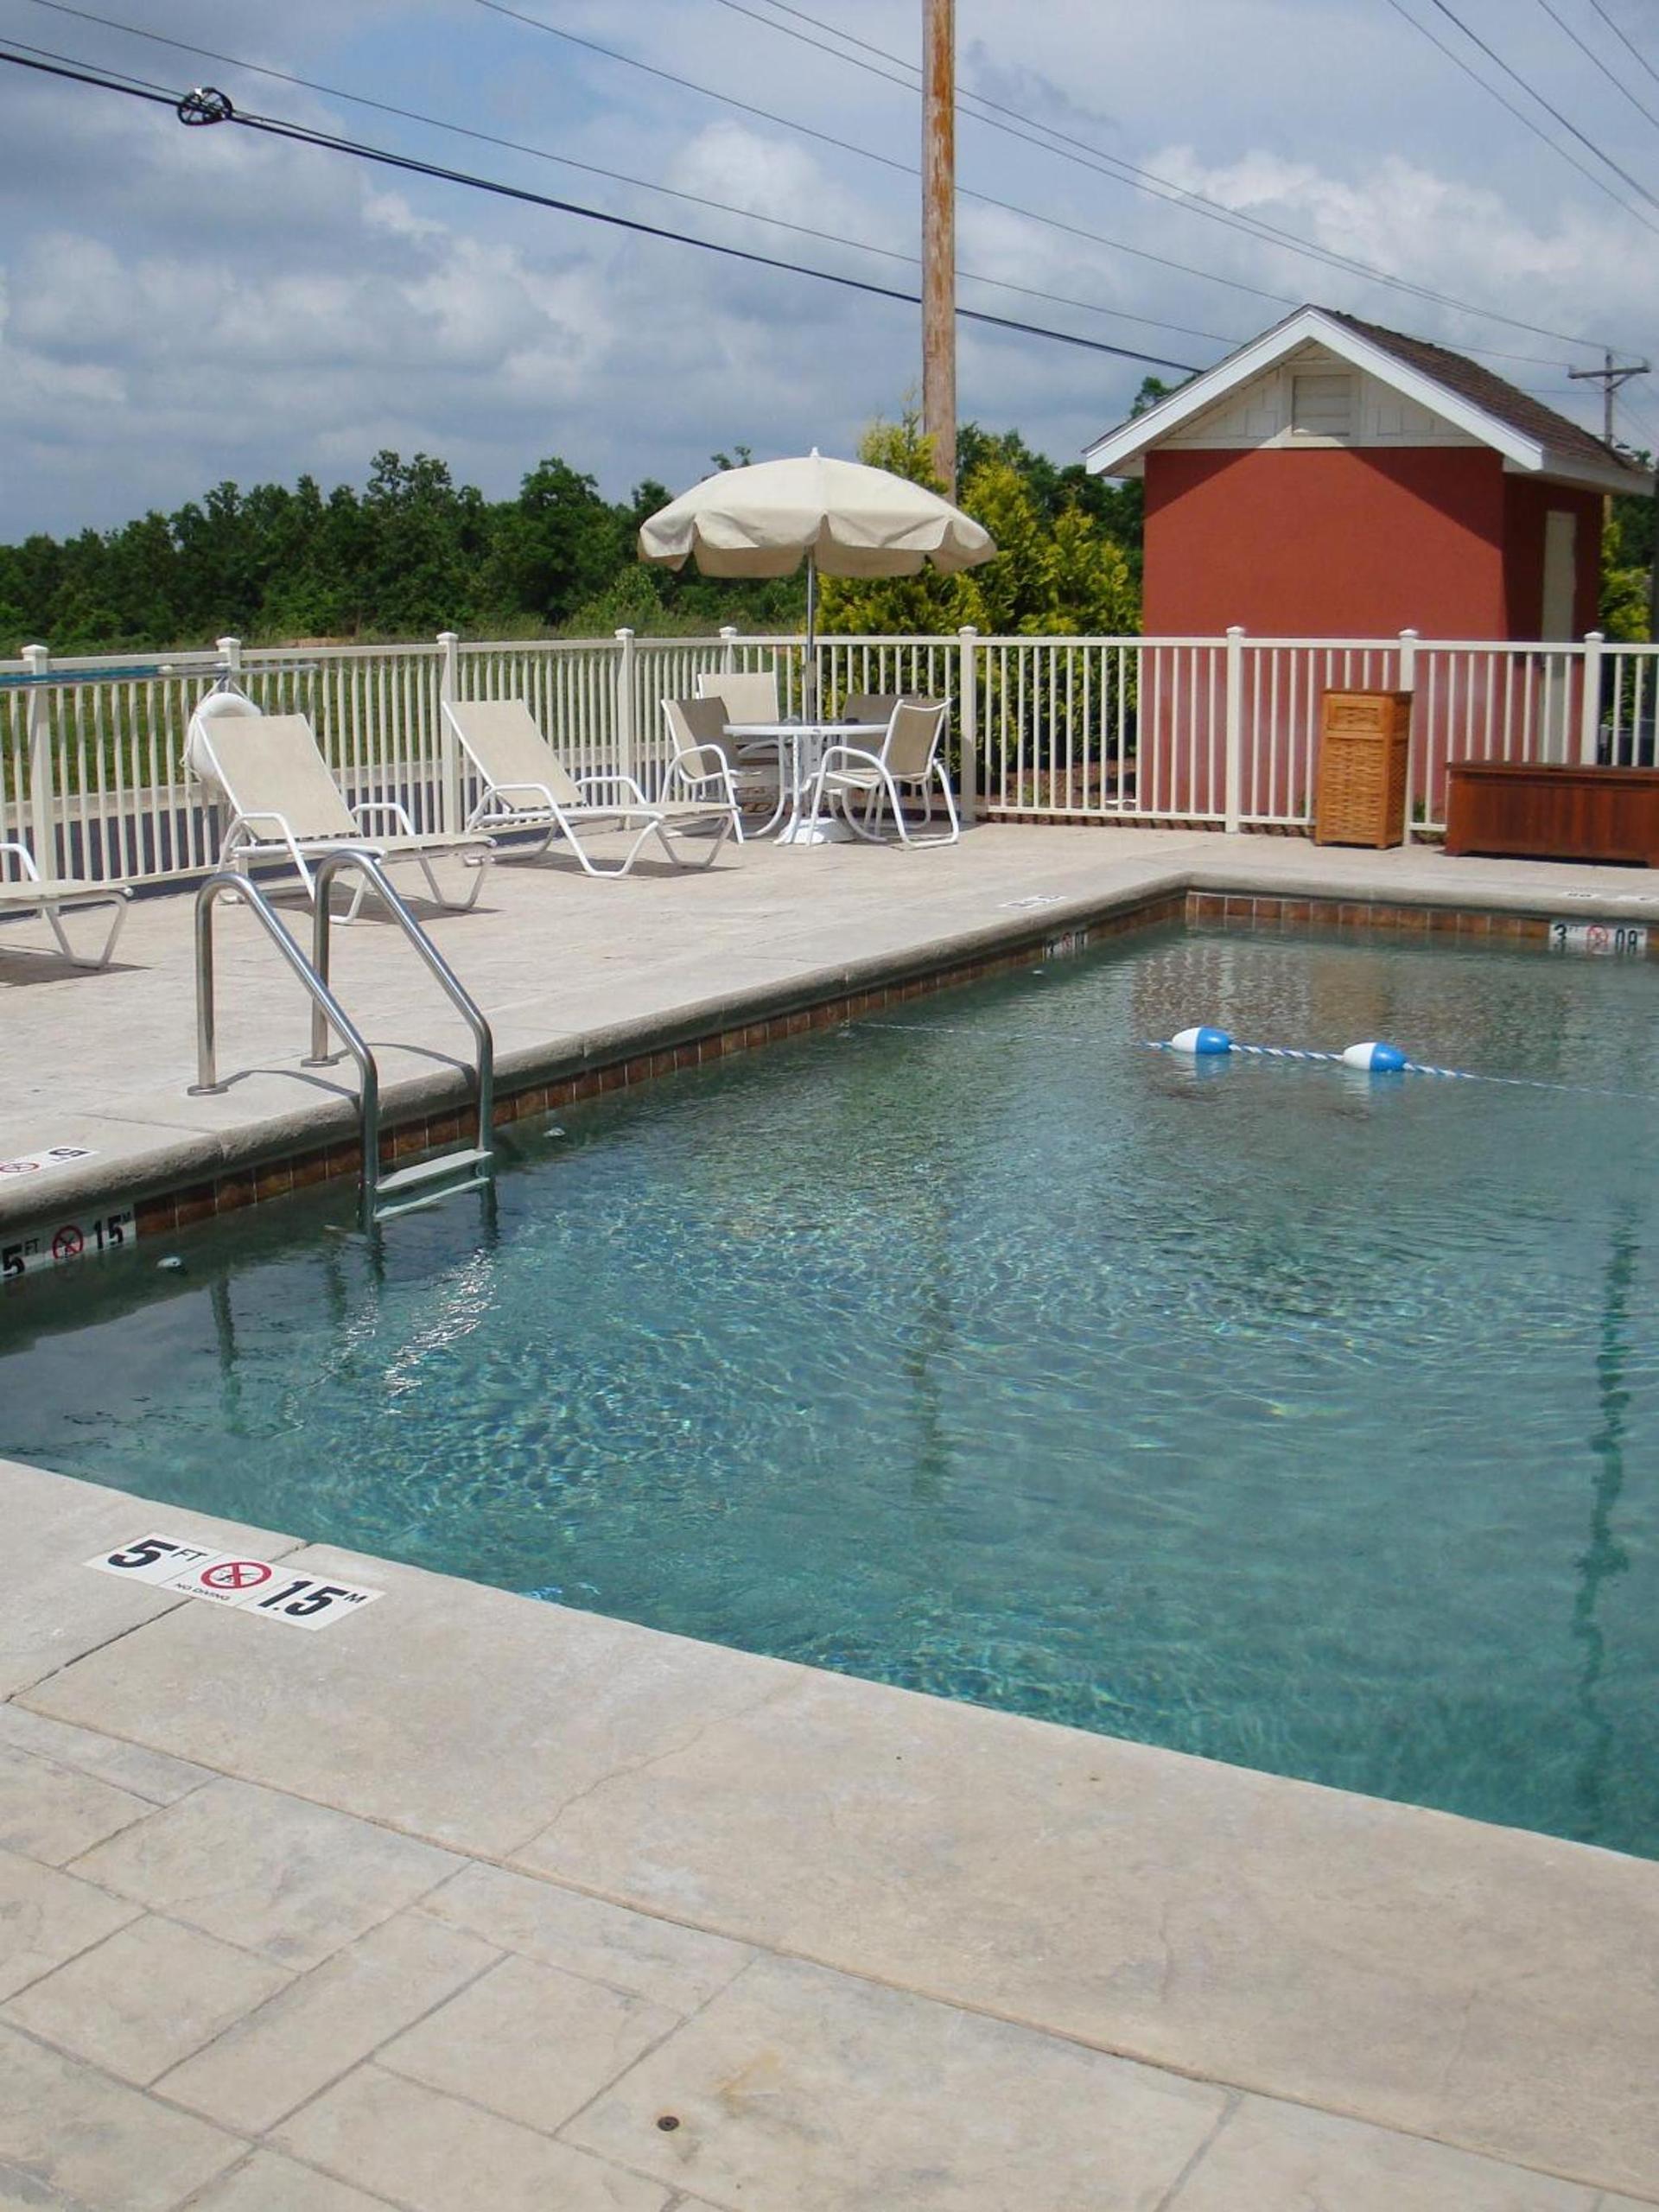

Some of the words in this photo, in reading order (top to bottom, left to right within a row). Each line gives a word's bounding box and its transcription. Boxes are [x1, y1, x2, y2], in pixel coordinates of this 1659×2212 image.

[1554, 924, 1567, 941] 3
[3, 1244, 25, 1276] 5
[25, 1238, 40, 1255] FT
[107, 1539, 180, 1568] 5
[171, 1548, 209, 1561] FT
[257, 1580, 349, 1615] 1.5
[344, 1593, 368, 1603] M
[192, 1587, 231, 1601] DIVING
